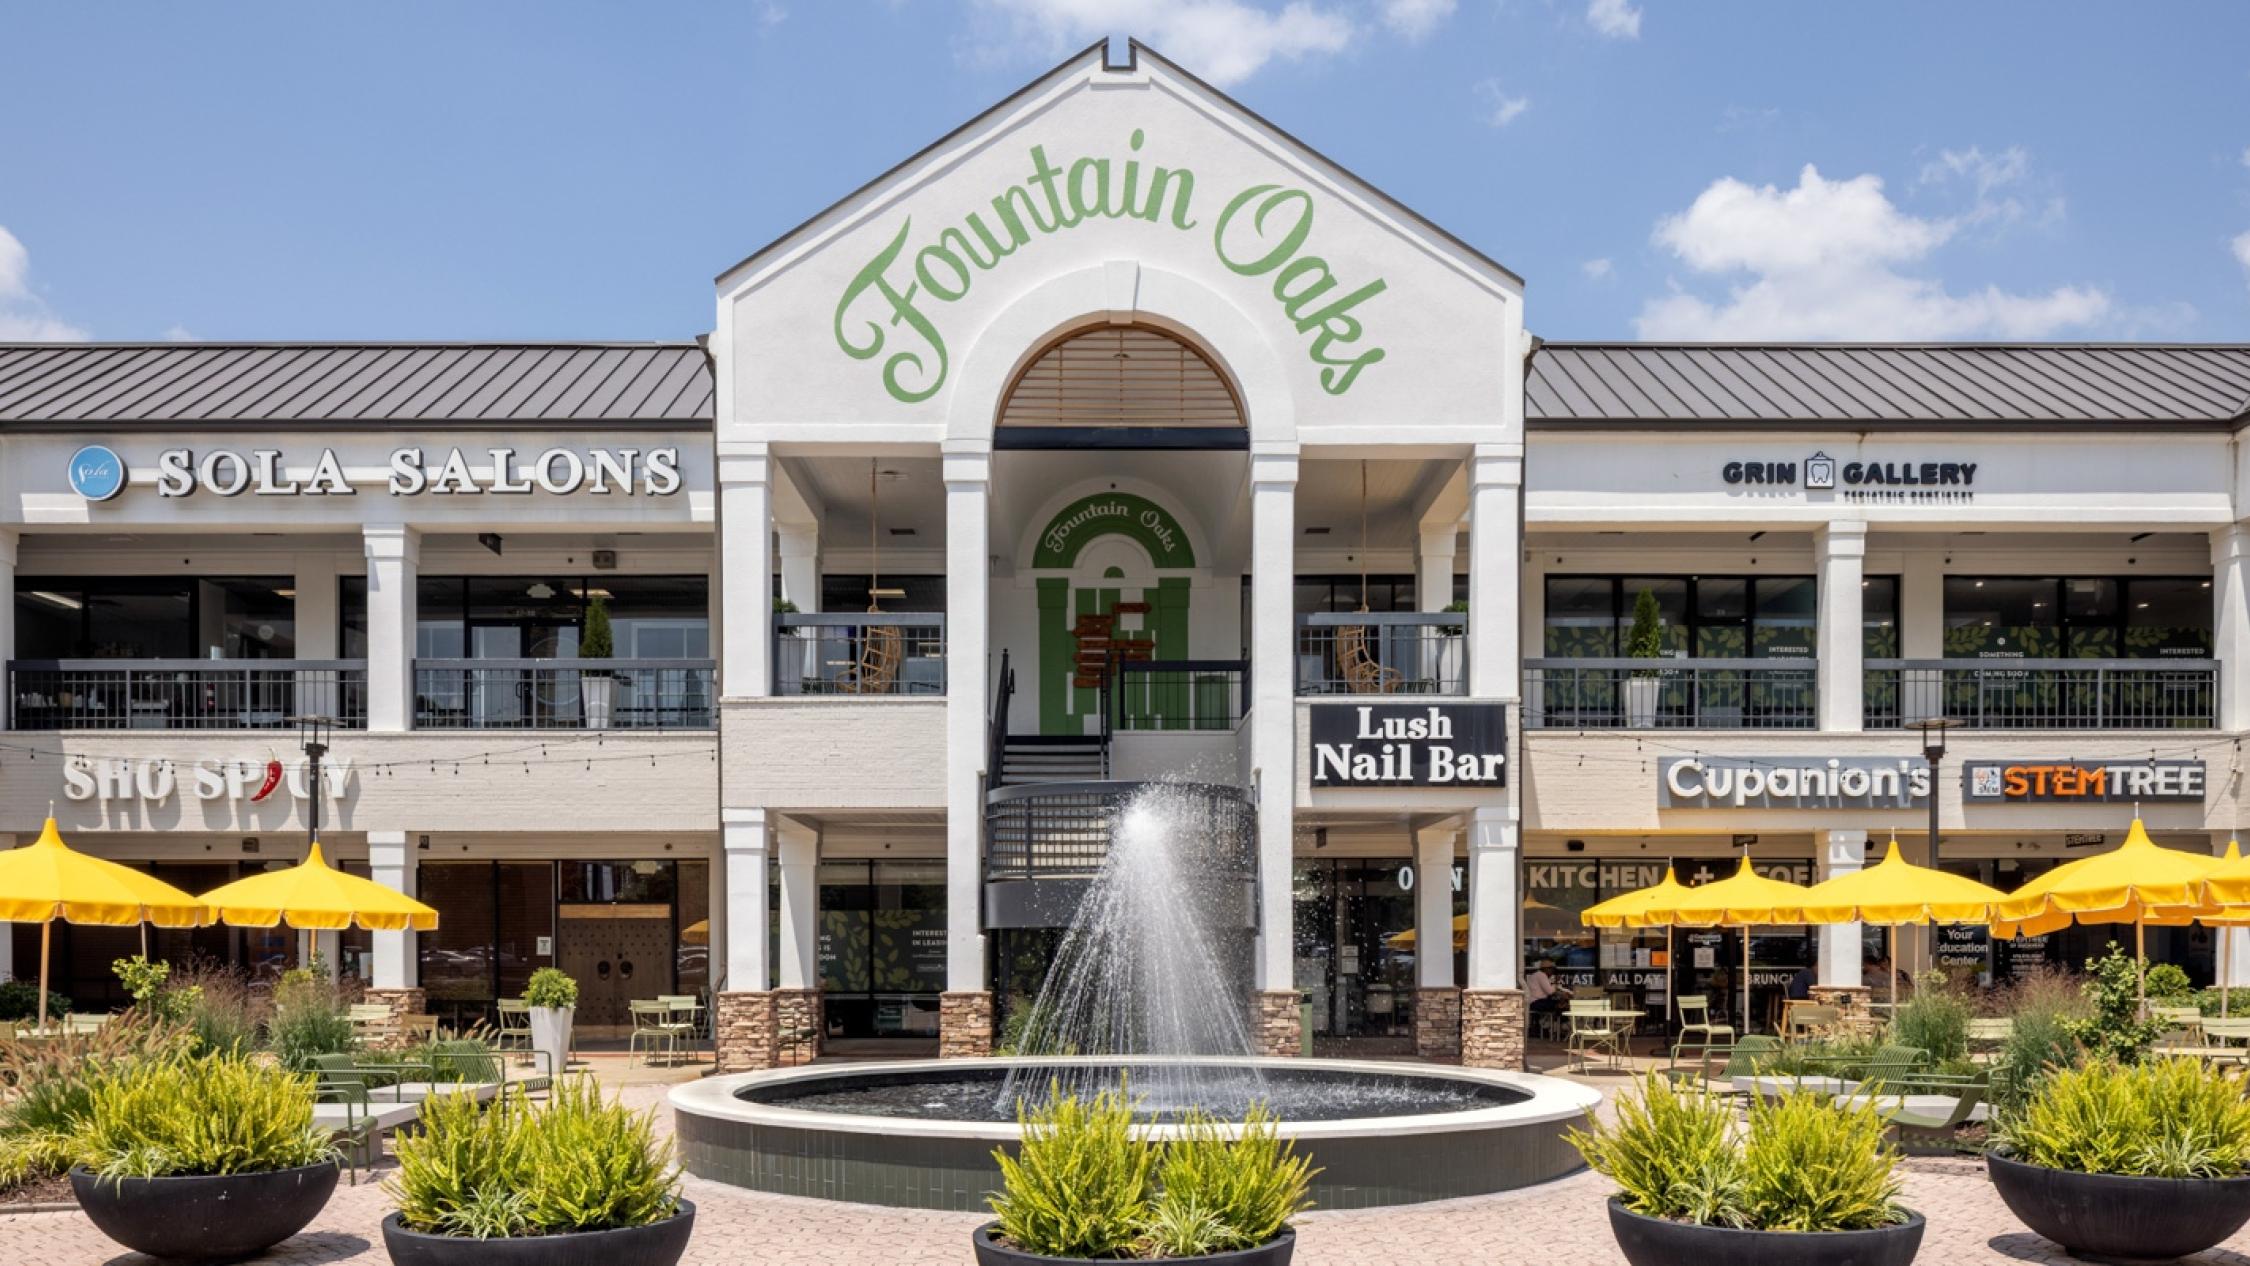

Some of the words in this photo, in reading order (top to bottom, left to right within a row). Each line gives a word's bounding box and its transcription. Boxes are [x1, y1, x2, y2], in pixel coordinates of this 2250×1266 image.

[834, 128, 1197, 403] Fountain
[1213, 183, 1387, 396] Oaks
[157, 447, 357, 497] SOLA
[388, 447, 682, 496] SALONS
[1722, 462, 1797, 485] GRIN
[1842, 462, 1978, 486] GALLERY
[1045, 501, 1130, 553] Fountain
[1140, 510, 1177, 552] Oaks
[1357, 706, 1454, 740] Lush
[63, 759, 176, 800] SHO
[1314, 743, 1414, 781] Nail
[1428, 746, 1505, 783] Bar
[1667, 758, 1931, 806] Cupanion's
[1399, 866, 1464, 891] ON
[1530, 866, 1659, 889] KITCHEN
[1947, 929, 1974, 940] Your
[1942, 955, 1979, 966] Center
[1609, 973, 1631, 985] ALL
